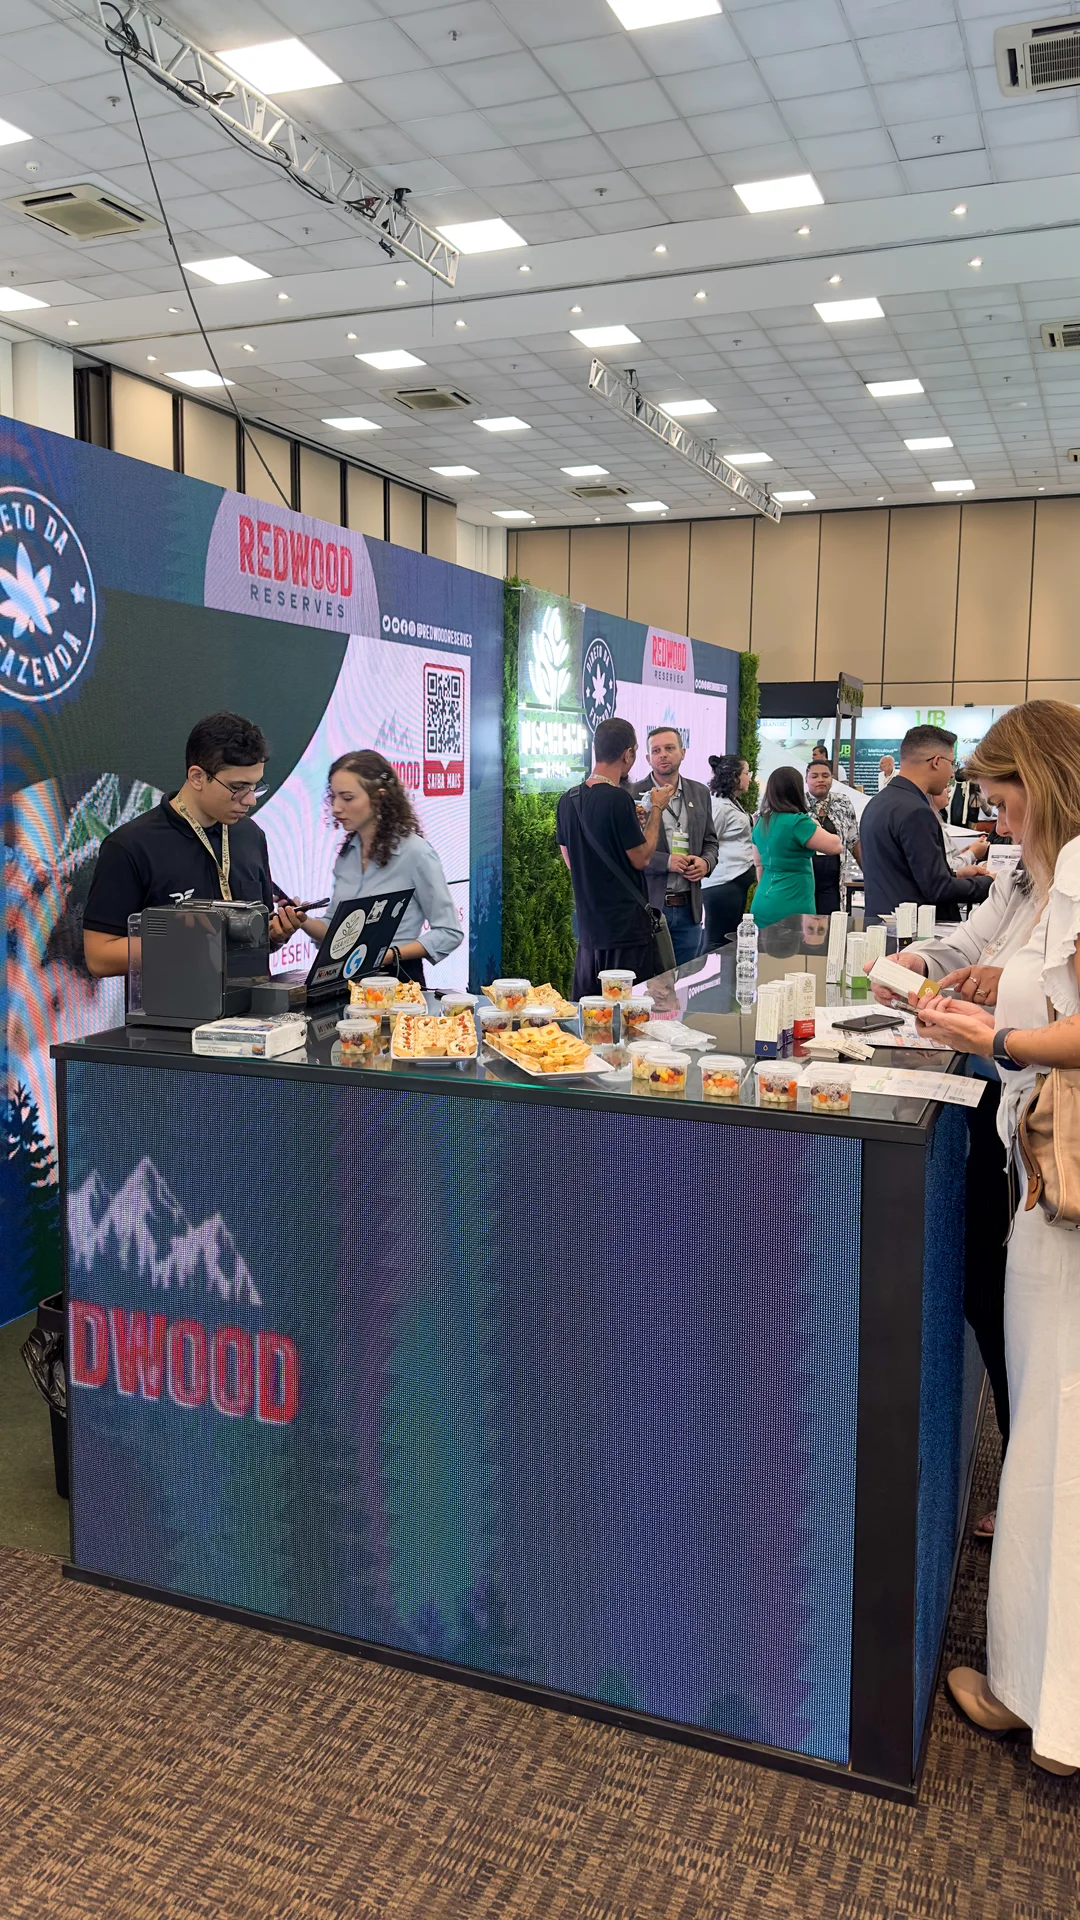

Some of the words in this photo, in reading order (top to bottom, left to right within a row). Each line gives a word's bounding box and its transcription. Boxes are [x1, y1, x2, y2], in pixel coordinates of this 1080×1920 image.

[0, 501, 35, 536] ETO
[44, 515, 68, 556] DA
[238, 513, 353, 598] REDWOOD
[249, 583, 345, 618] RESERVES
[651, 635, 687, 672] REDWOOD
[69, 1299, 299, 1425] DWOOD
